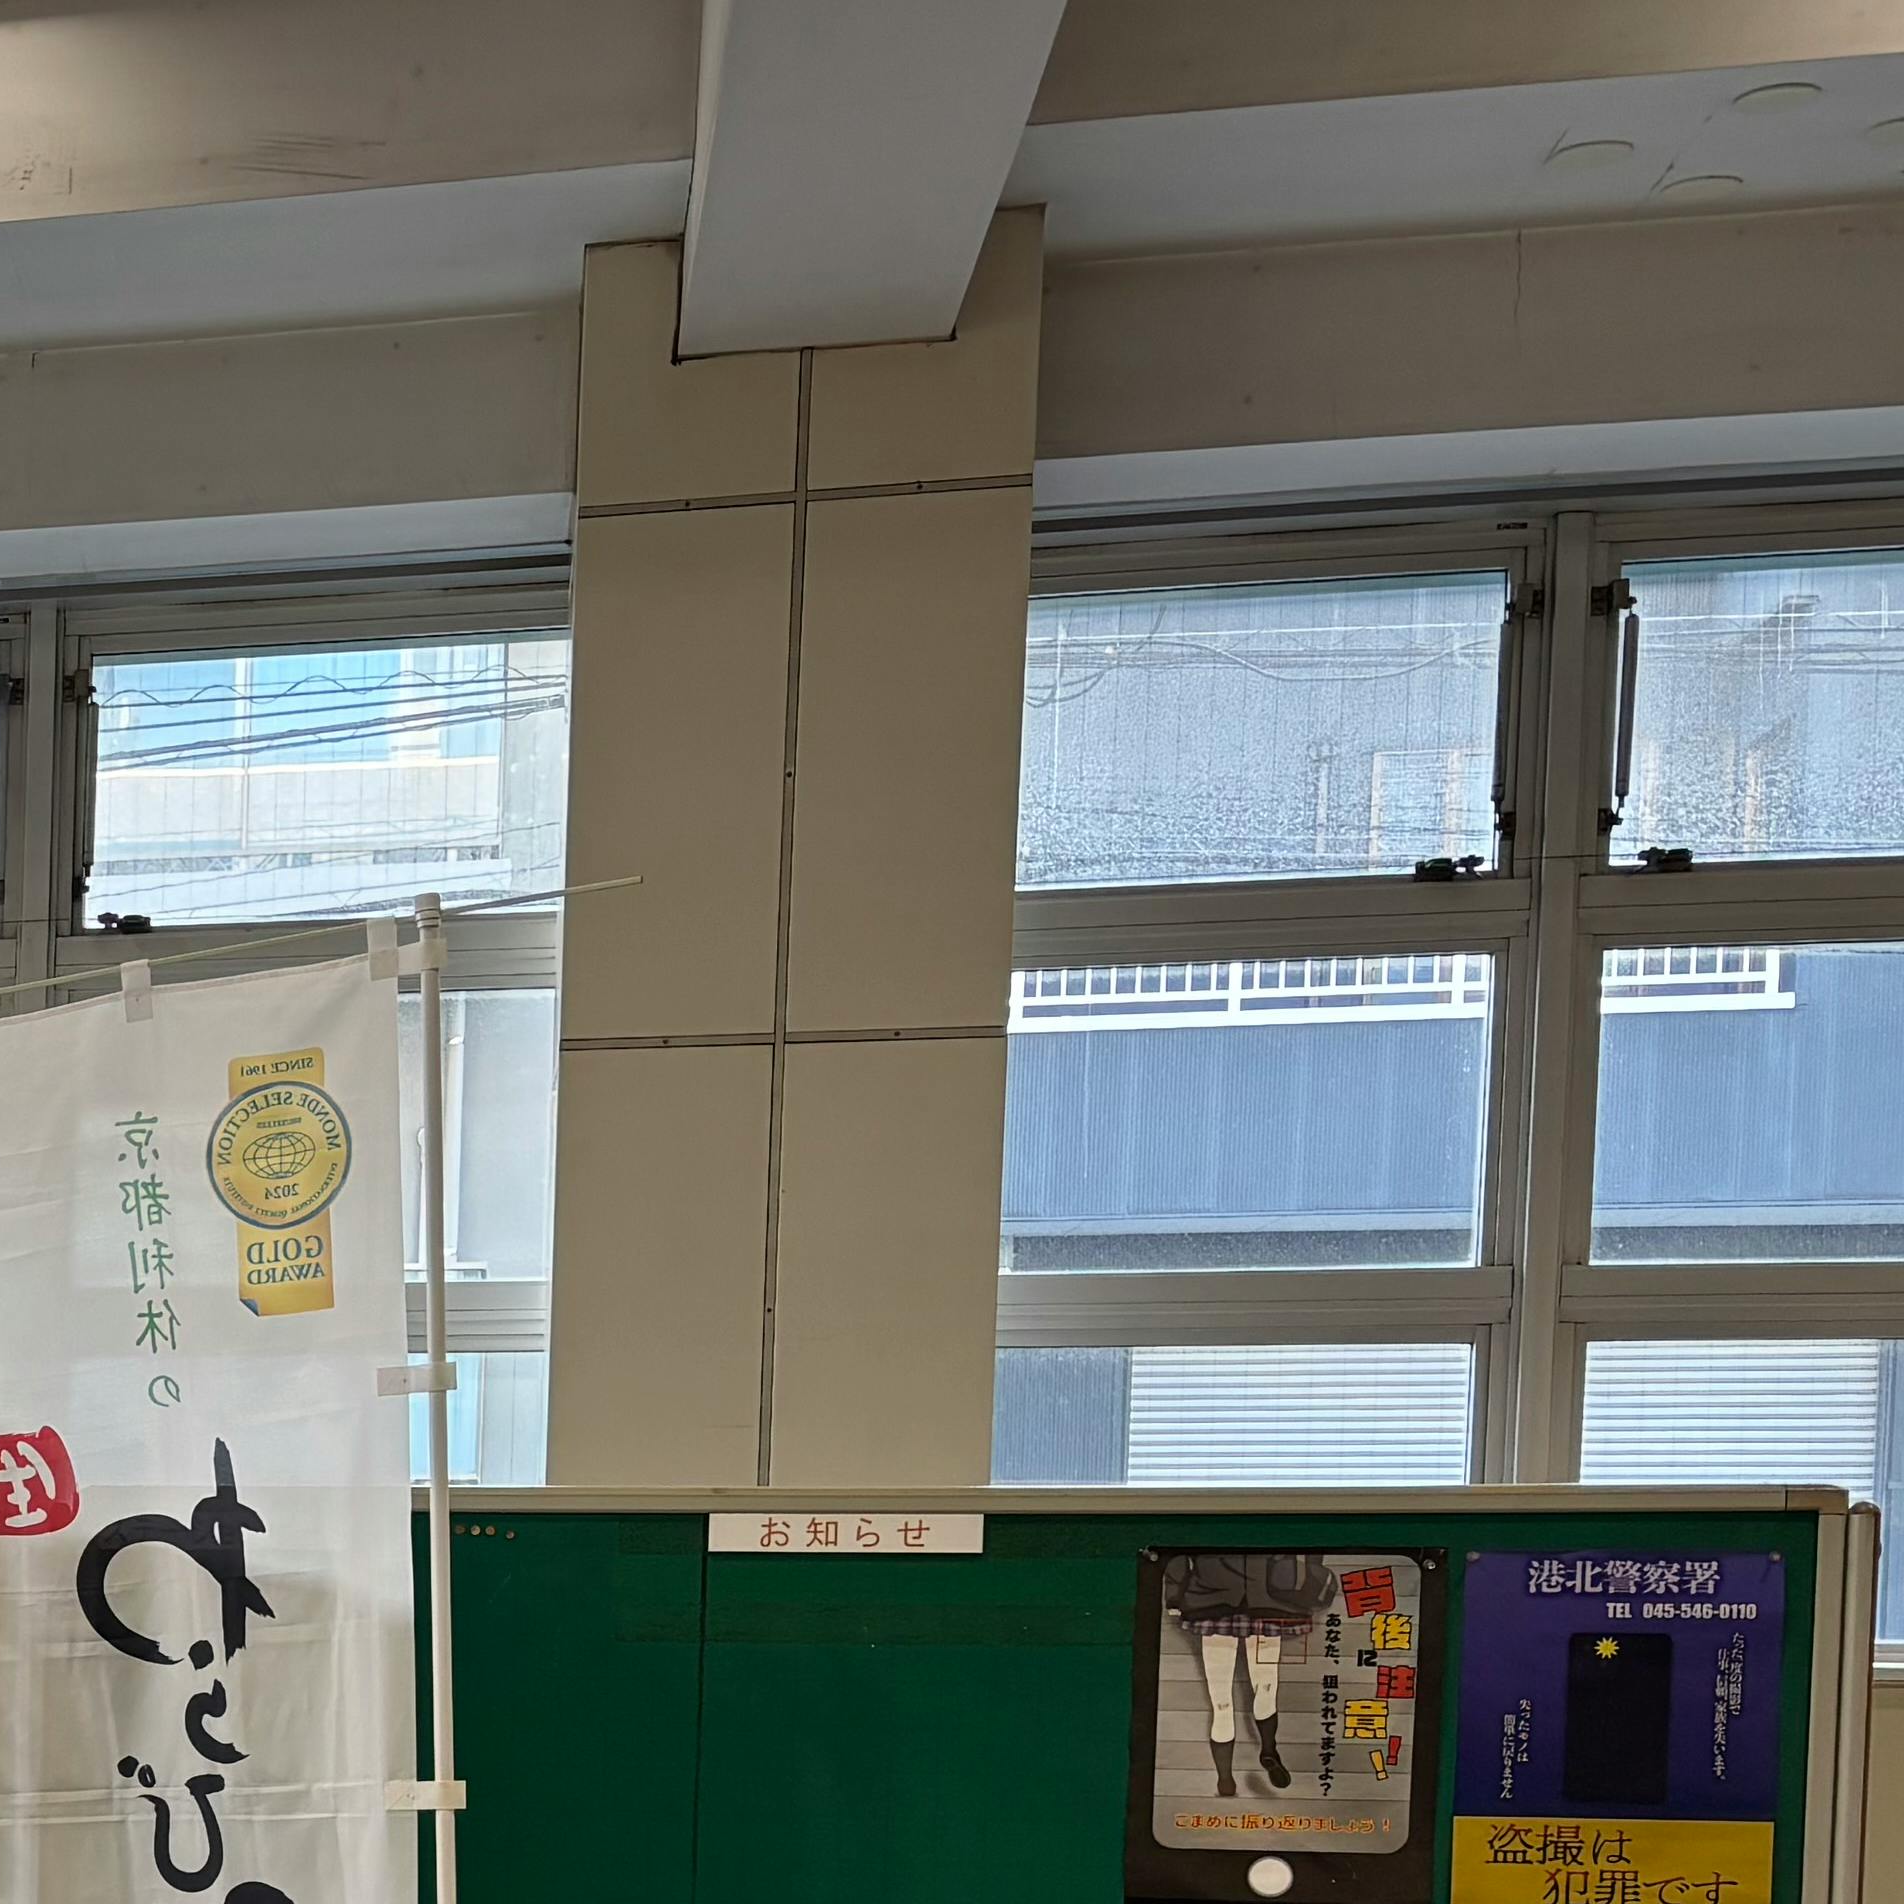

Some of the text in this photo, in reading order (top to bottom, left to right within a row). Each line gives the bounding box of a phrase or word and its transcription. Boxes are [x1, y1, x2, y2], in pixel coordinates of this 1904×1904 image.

[759, 1516, 931, 1548] お知らせ
[1527, 1560, 1721, 1595] 港北警察署
[1606, 1602, 1757, 1620] TEL 045-546-0110
[1485, 1824, 1634, 1866] 盗撮は
